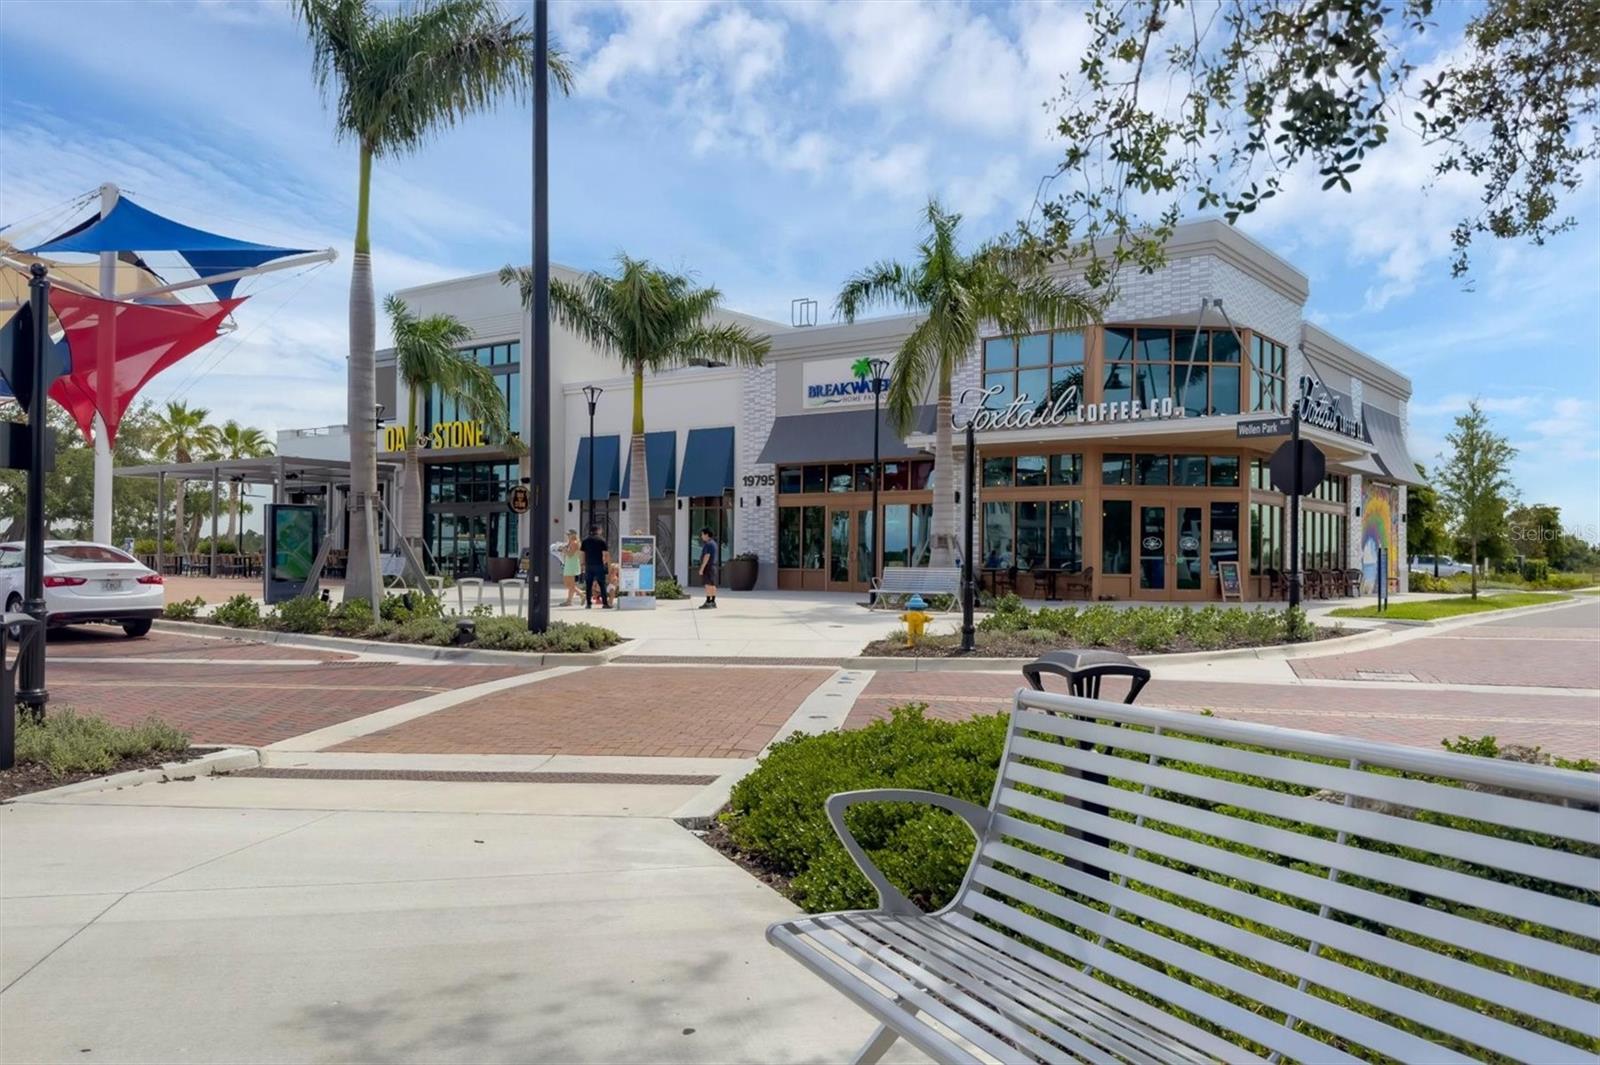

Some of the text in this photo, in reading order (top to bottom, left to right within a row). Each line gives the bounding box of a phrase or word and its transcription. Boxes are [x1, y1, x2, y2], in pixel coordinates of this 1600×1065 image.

[952, 384, 1077, 431] Foxtail
[1077, 401, 1141, 422] COFFEE
[385, 426, 414, 452] OA
[433, 419, 485, 448] STONE
[1238, 424, 1261, 435] Wellen
[1262, 422, 1278, 434] Park
[742, 474, 776, 487] 19795
